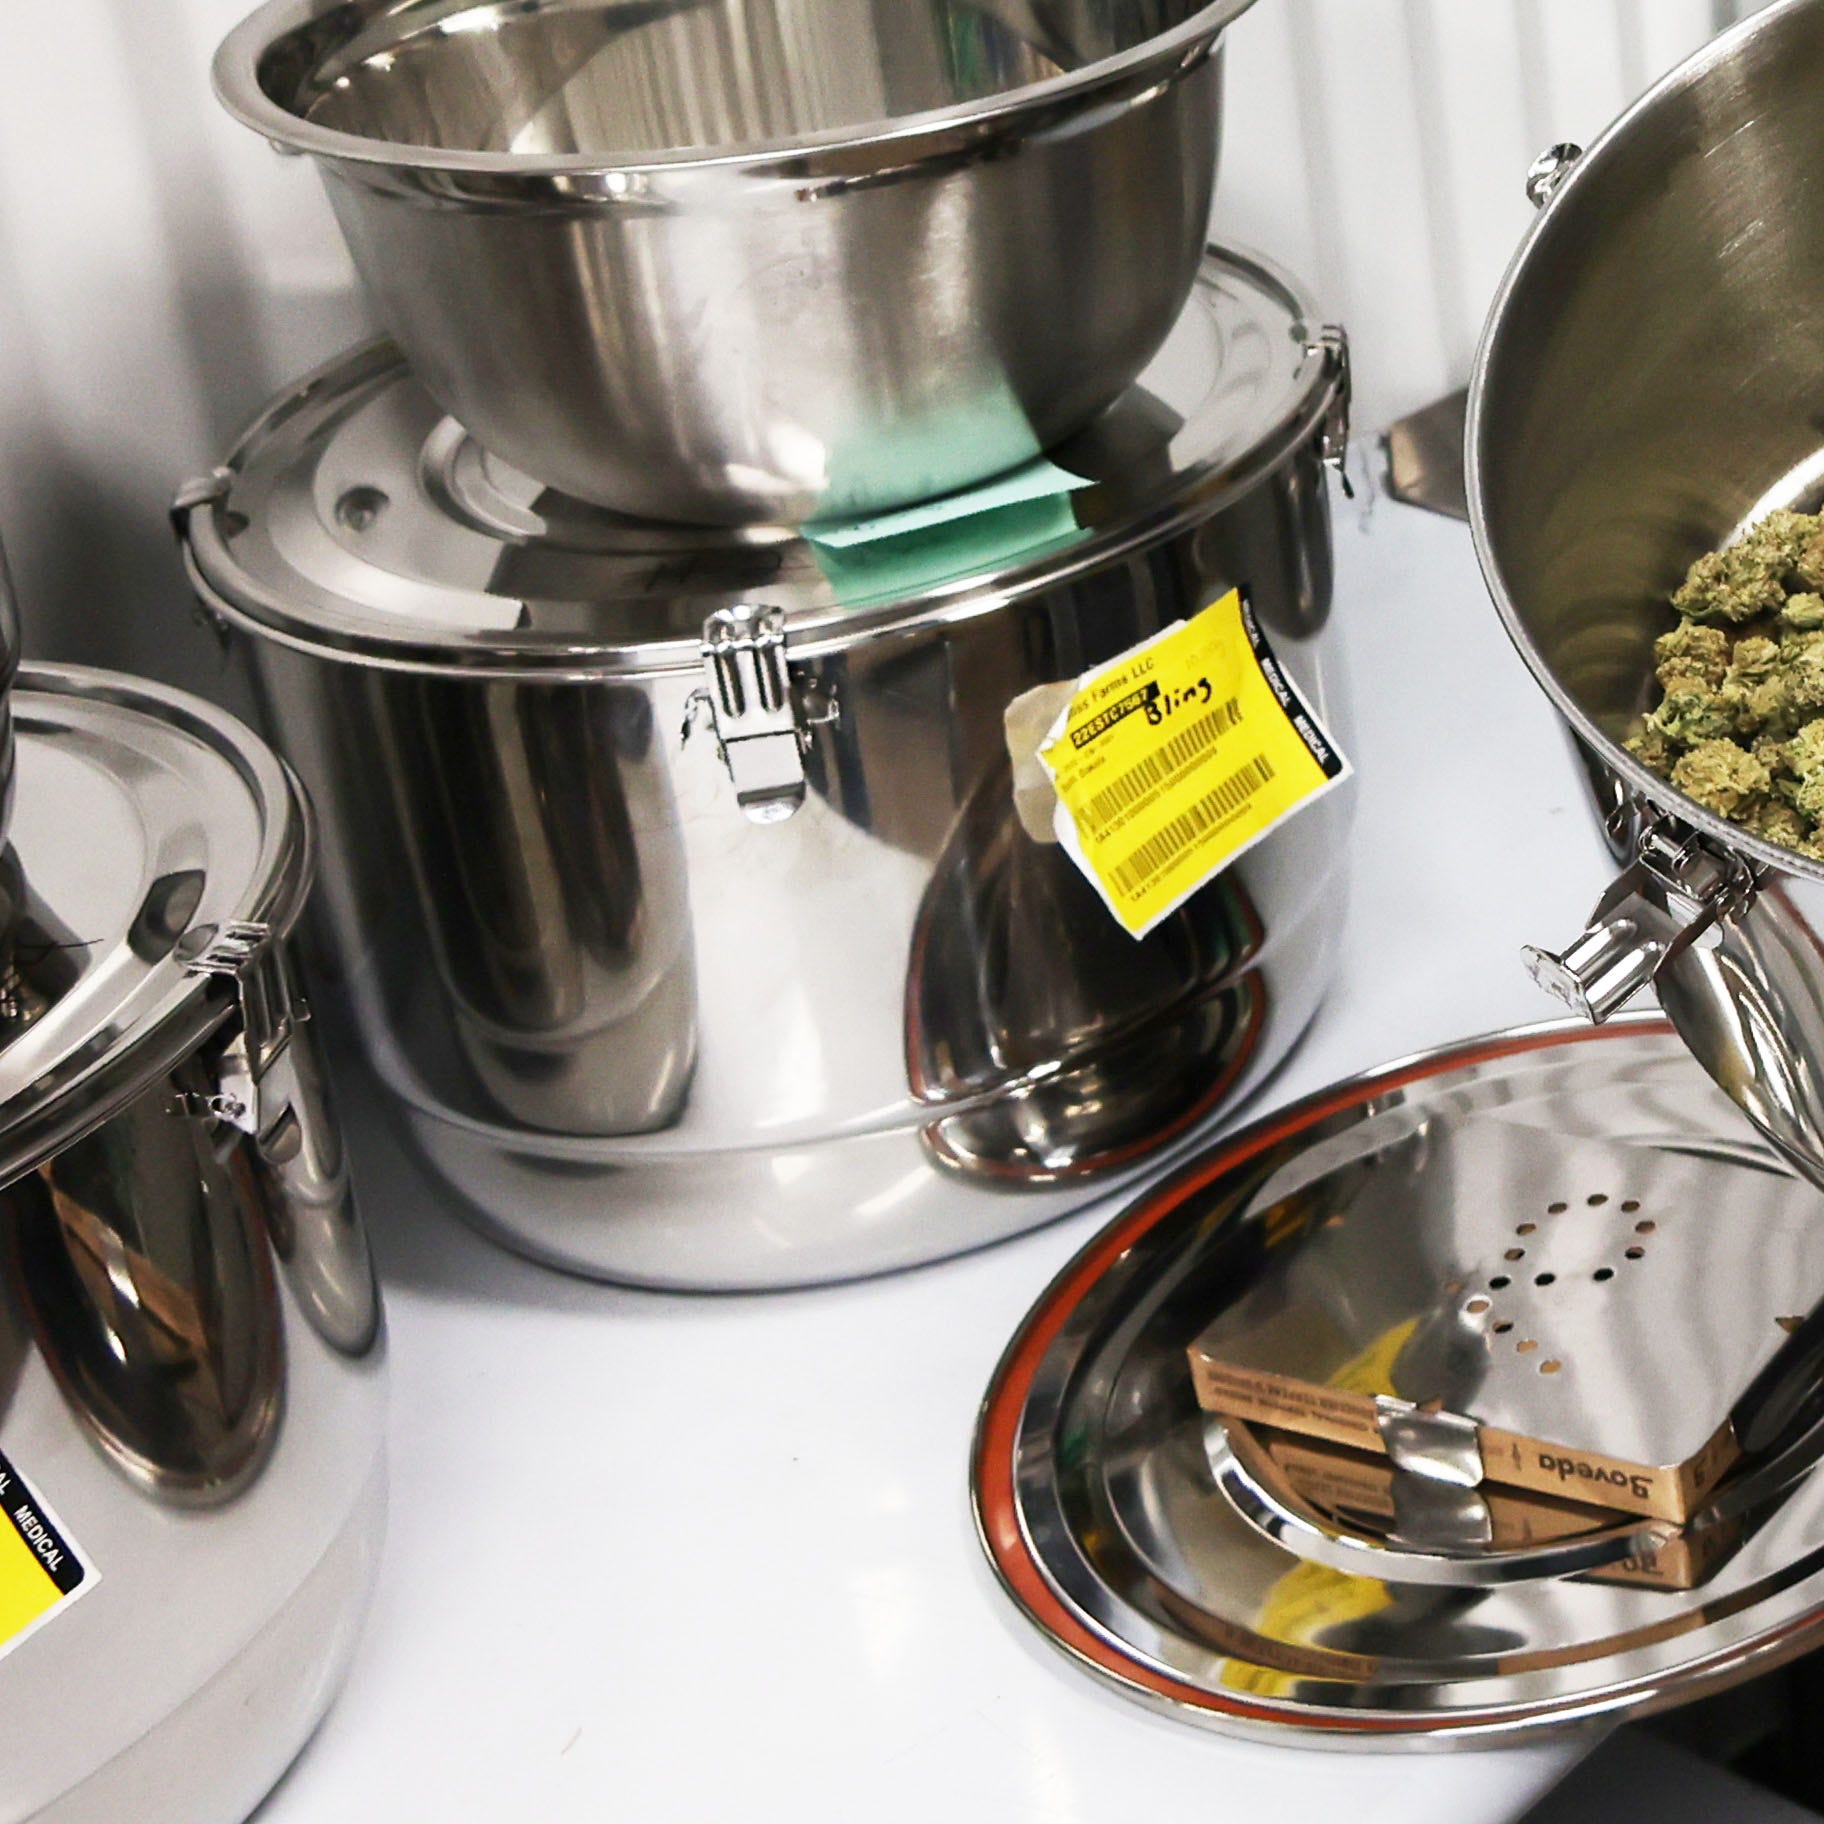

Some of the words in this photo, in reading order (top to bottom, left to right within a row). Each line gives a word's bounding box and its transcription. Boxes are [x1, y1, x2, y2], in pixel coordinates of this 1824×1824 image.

[1131, 657, 1155, 679] LLC
[1143, 677, 1213, 725] Bling
[1261, 656, 1292, 708] MEDICAL
[1293, 714, 1330, 766] MEDICAL
[1538, 1453, 1654, 1499] Boveda
[12, 1503, 64, 1572] MEDICAL
